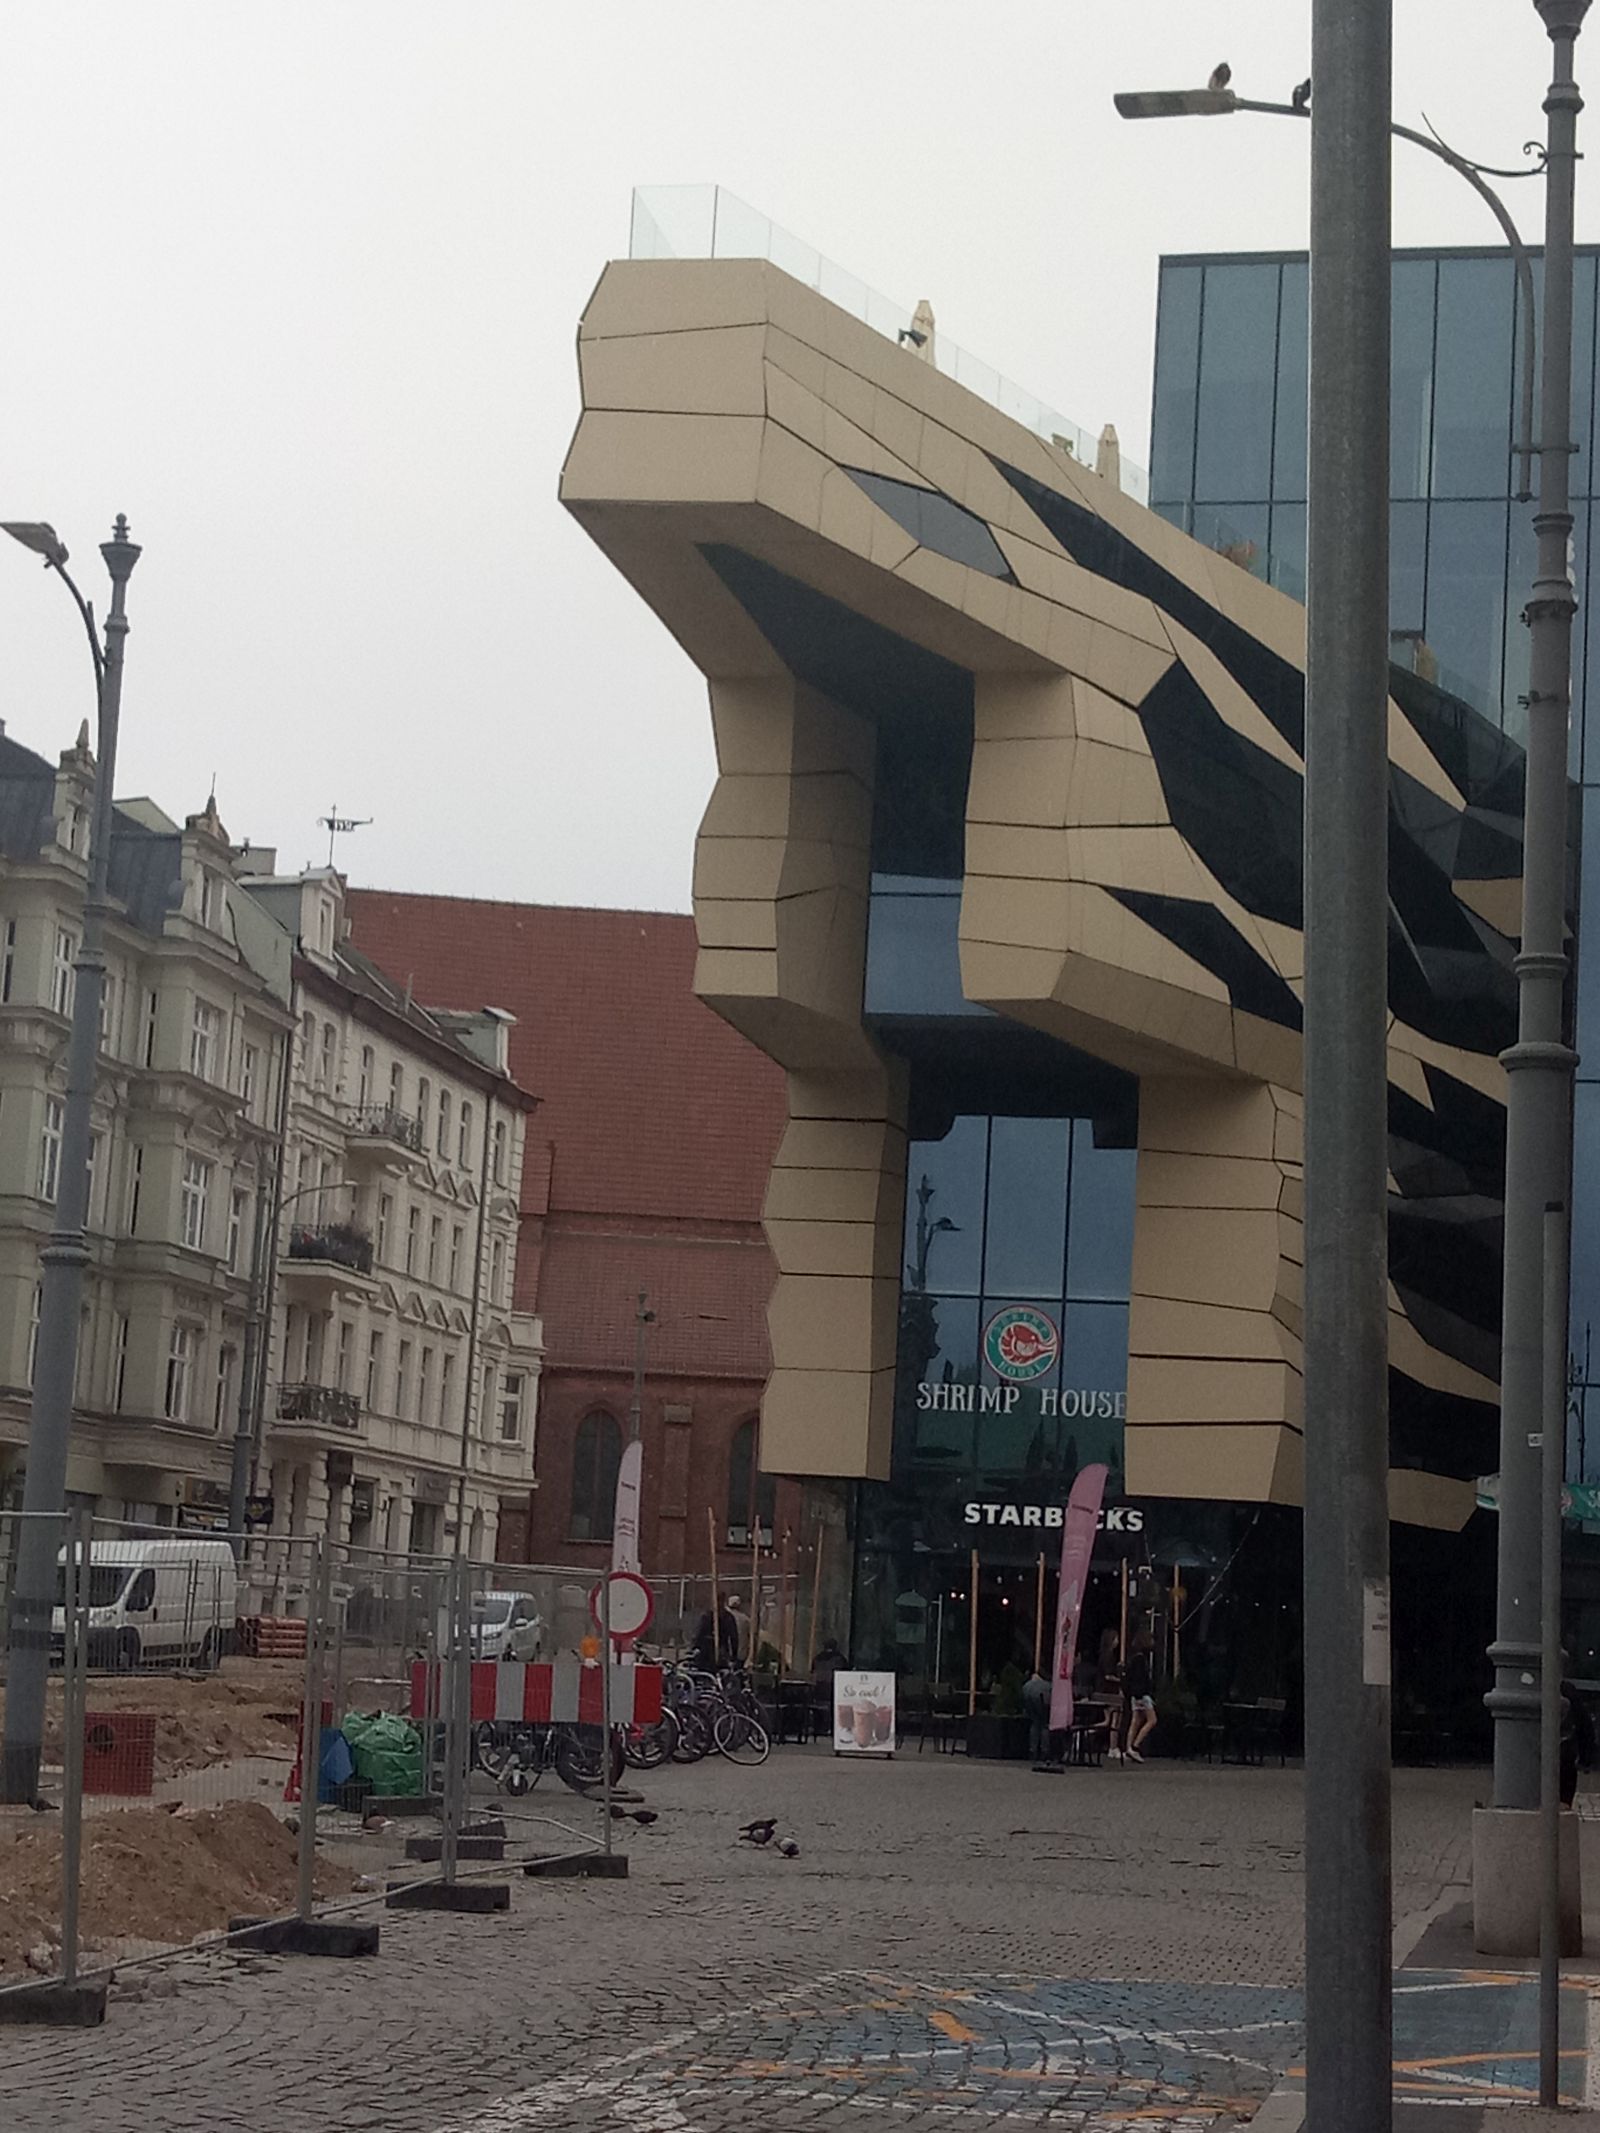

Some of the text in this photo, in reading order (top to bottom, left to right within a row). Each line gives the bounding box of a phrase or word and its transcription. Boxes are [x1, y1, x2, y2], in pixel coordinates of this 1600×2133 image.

[916, 1381, 1127, 1419] SHRIMP HOUSE
[964, 1503, 1143, 1532] STARBKS
